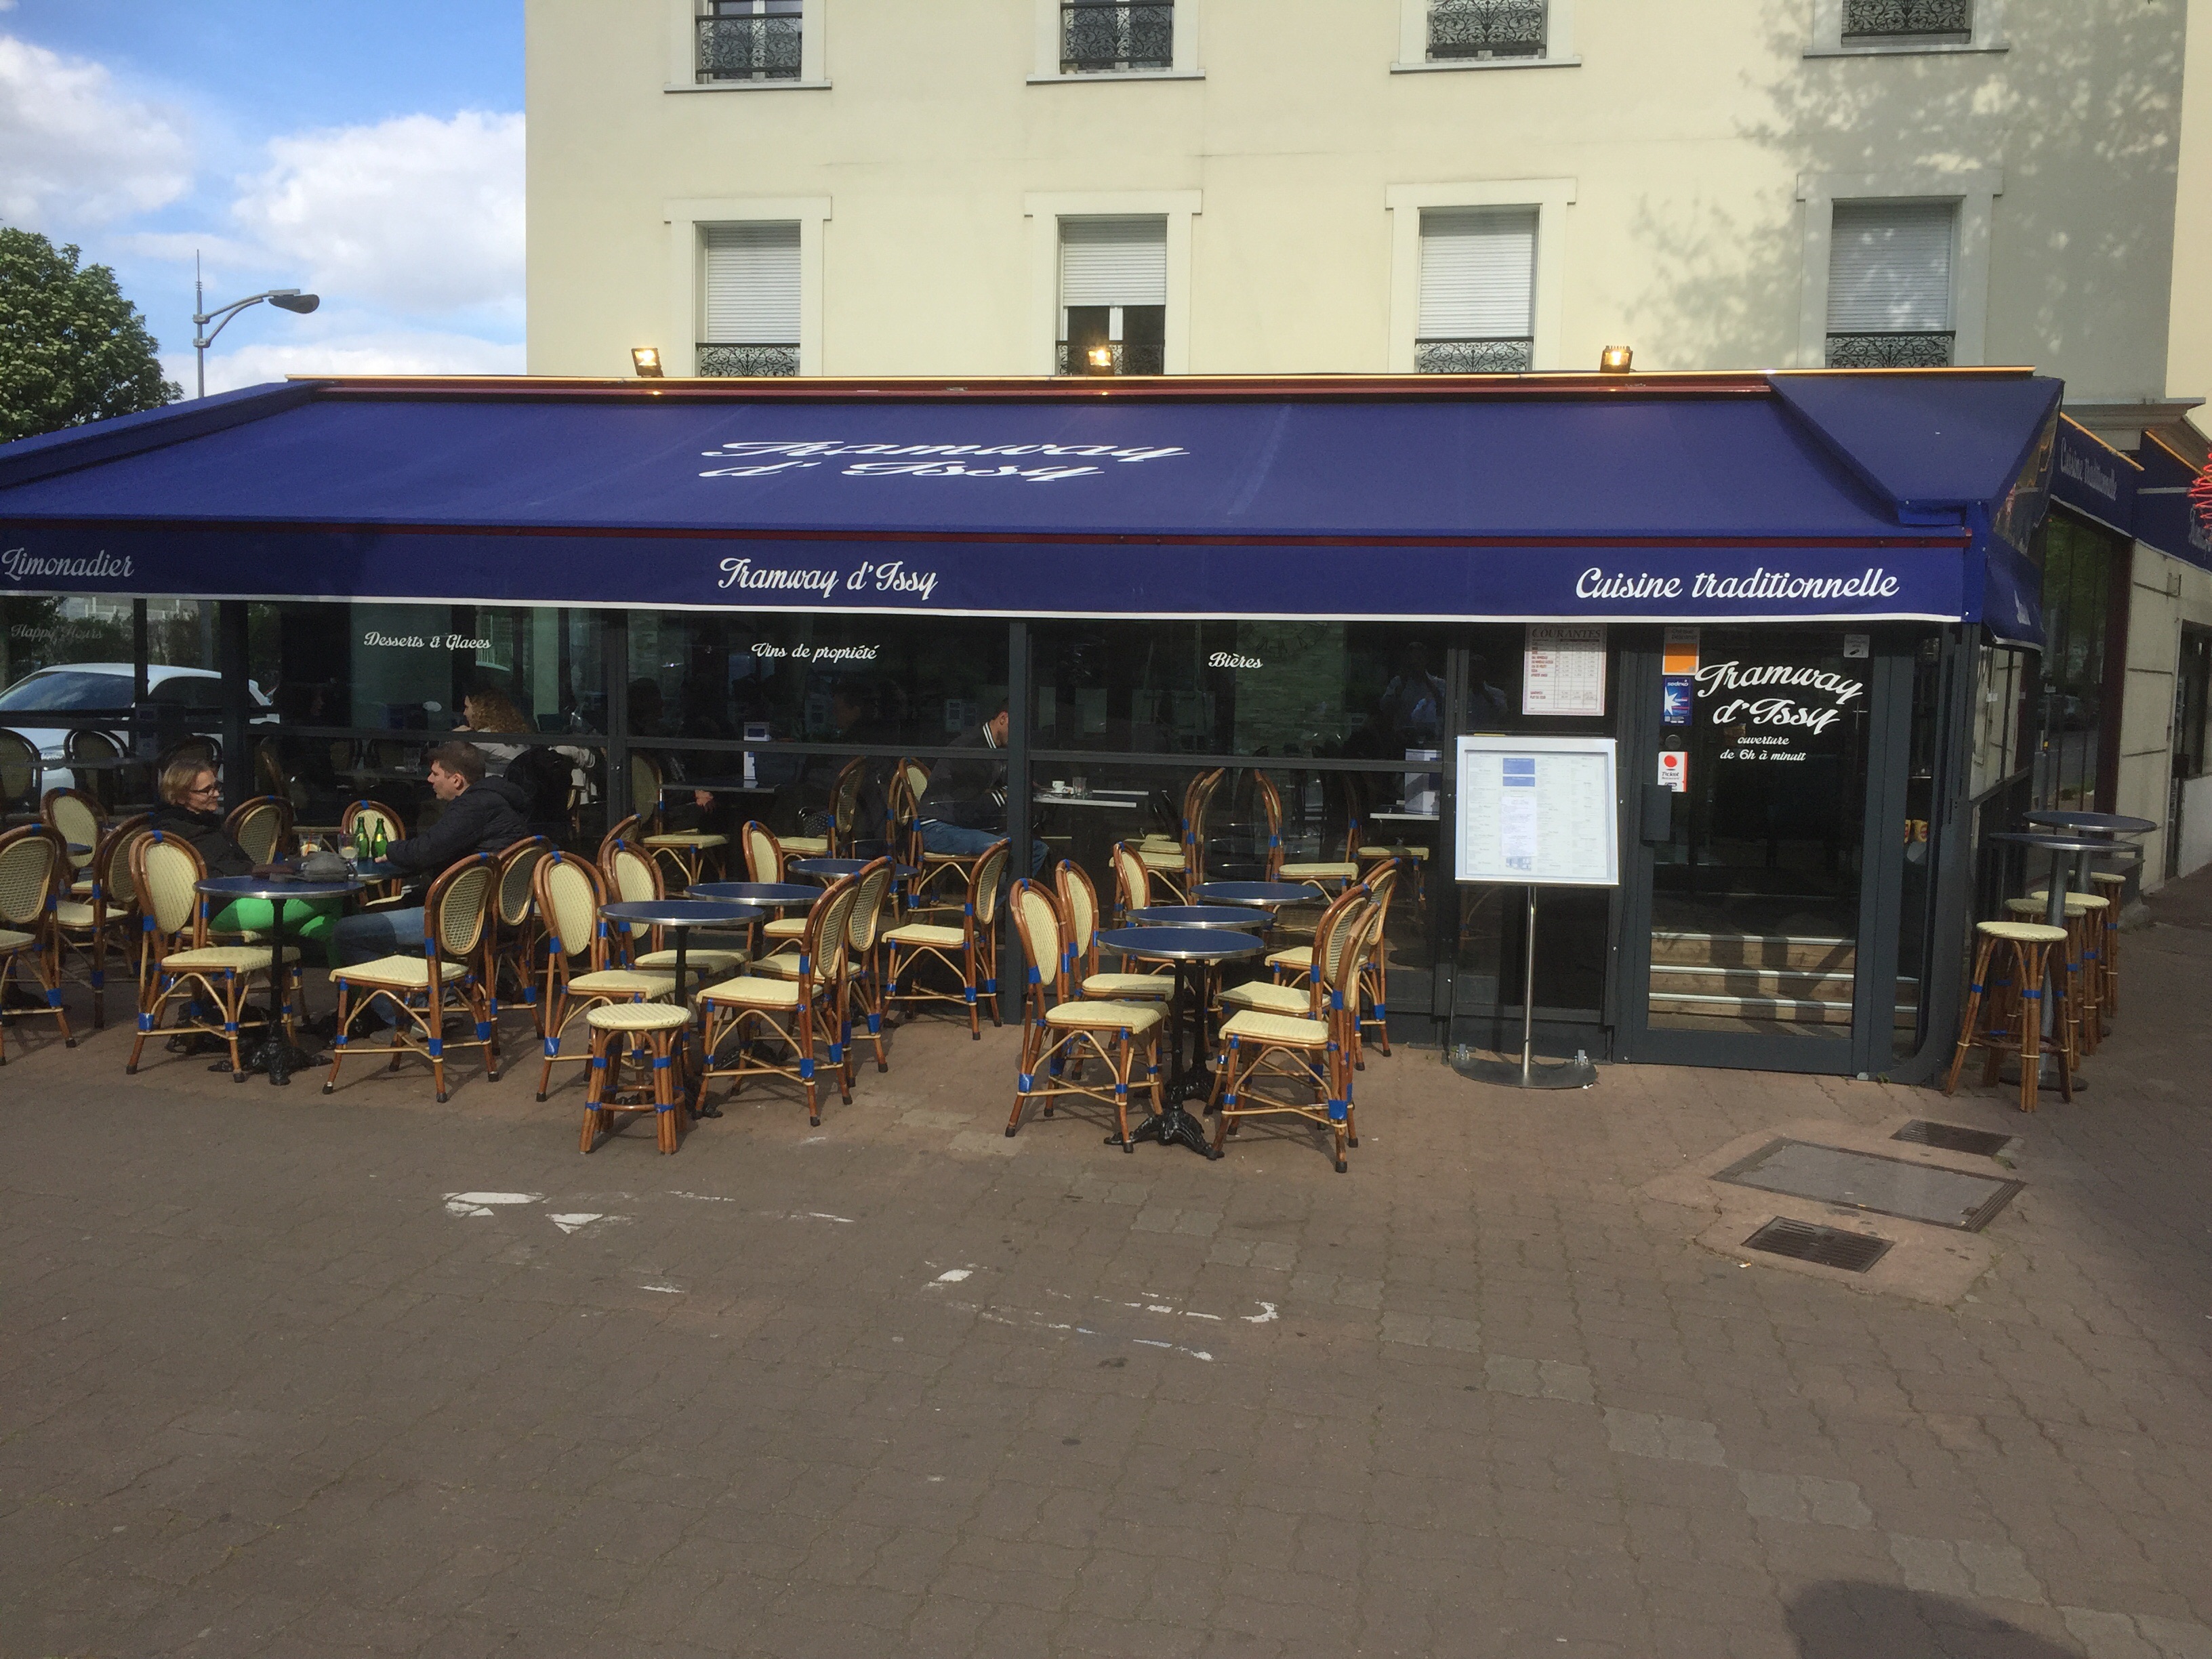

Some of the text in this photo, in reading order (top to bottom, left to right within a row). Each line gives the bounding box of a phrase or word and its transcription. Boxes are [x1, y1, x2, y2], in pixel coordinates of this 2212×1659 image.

[701, 441, 1190, 463] Tramway
[1, 547, 135, 581] Limonadier
[718, 558, 939, 600] Tramway d'Issy
[1576, 567, 1900, 598] Cuisine traditionnelle
[11, 623, 56, 642] Happy
[363, 631, 492, 651] Desserts & Glaces
[1532, 628, 1601, 638] COURANTES
[751, 642, 880, 663] Vins de propriété
[1208, 652, 1263, 669] Bières
[1694, 660, 1864, 705] Tramway
[1713, 698, 1840, 735] d'Issy
[1737, 735, 1790, 745] ouverture
[1719, 748, 1807, 761] de 6h à minuit
